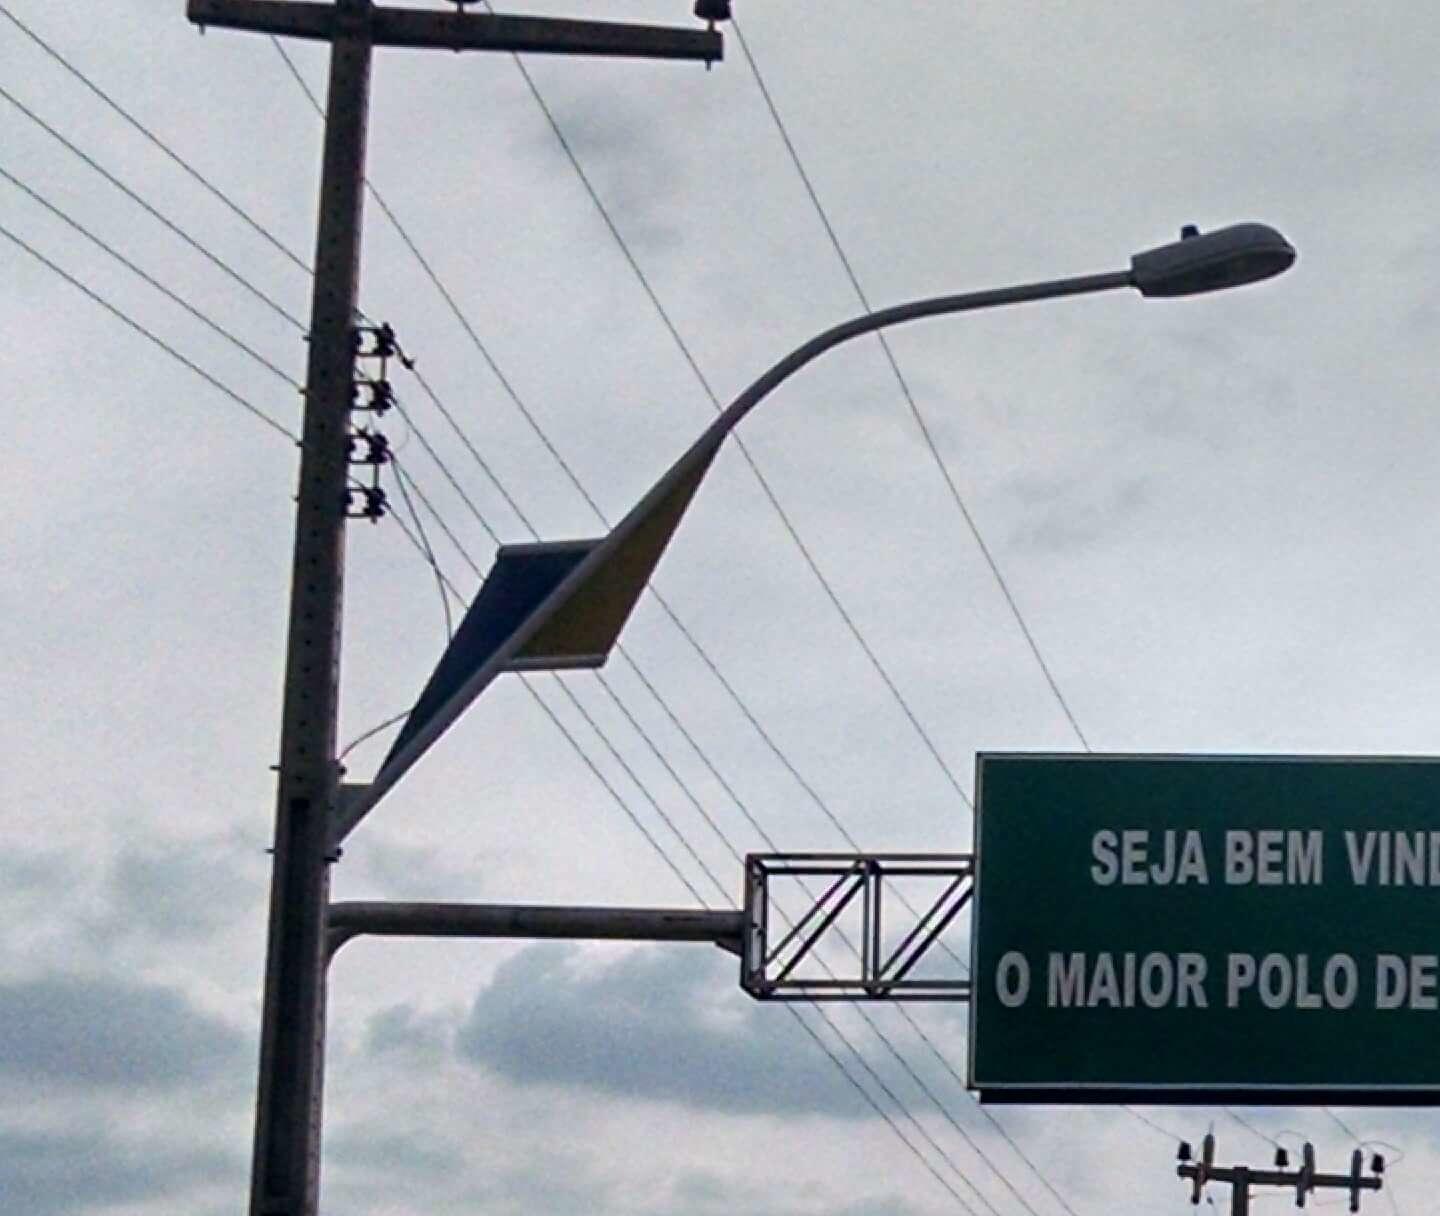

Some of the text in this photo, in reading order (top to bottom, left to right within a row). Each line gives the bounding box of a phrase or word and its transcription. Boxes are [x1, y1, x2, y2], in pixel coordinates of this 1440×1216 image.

[1090, 829, 1209, 886] SEJA
[1224, 829, 1324, 886] BEM
[996, 951, 1030, 1008] O
[1047, 951, 1208, 1009] MAIOR
[1226, 952, 1358, 1010] POLO
[1375, 953, 1439, 1011] DE
